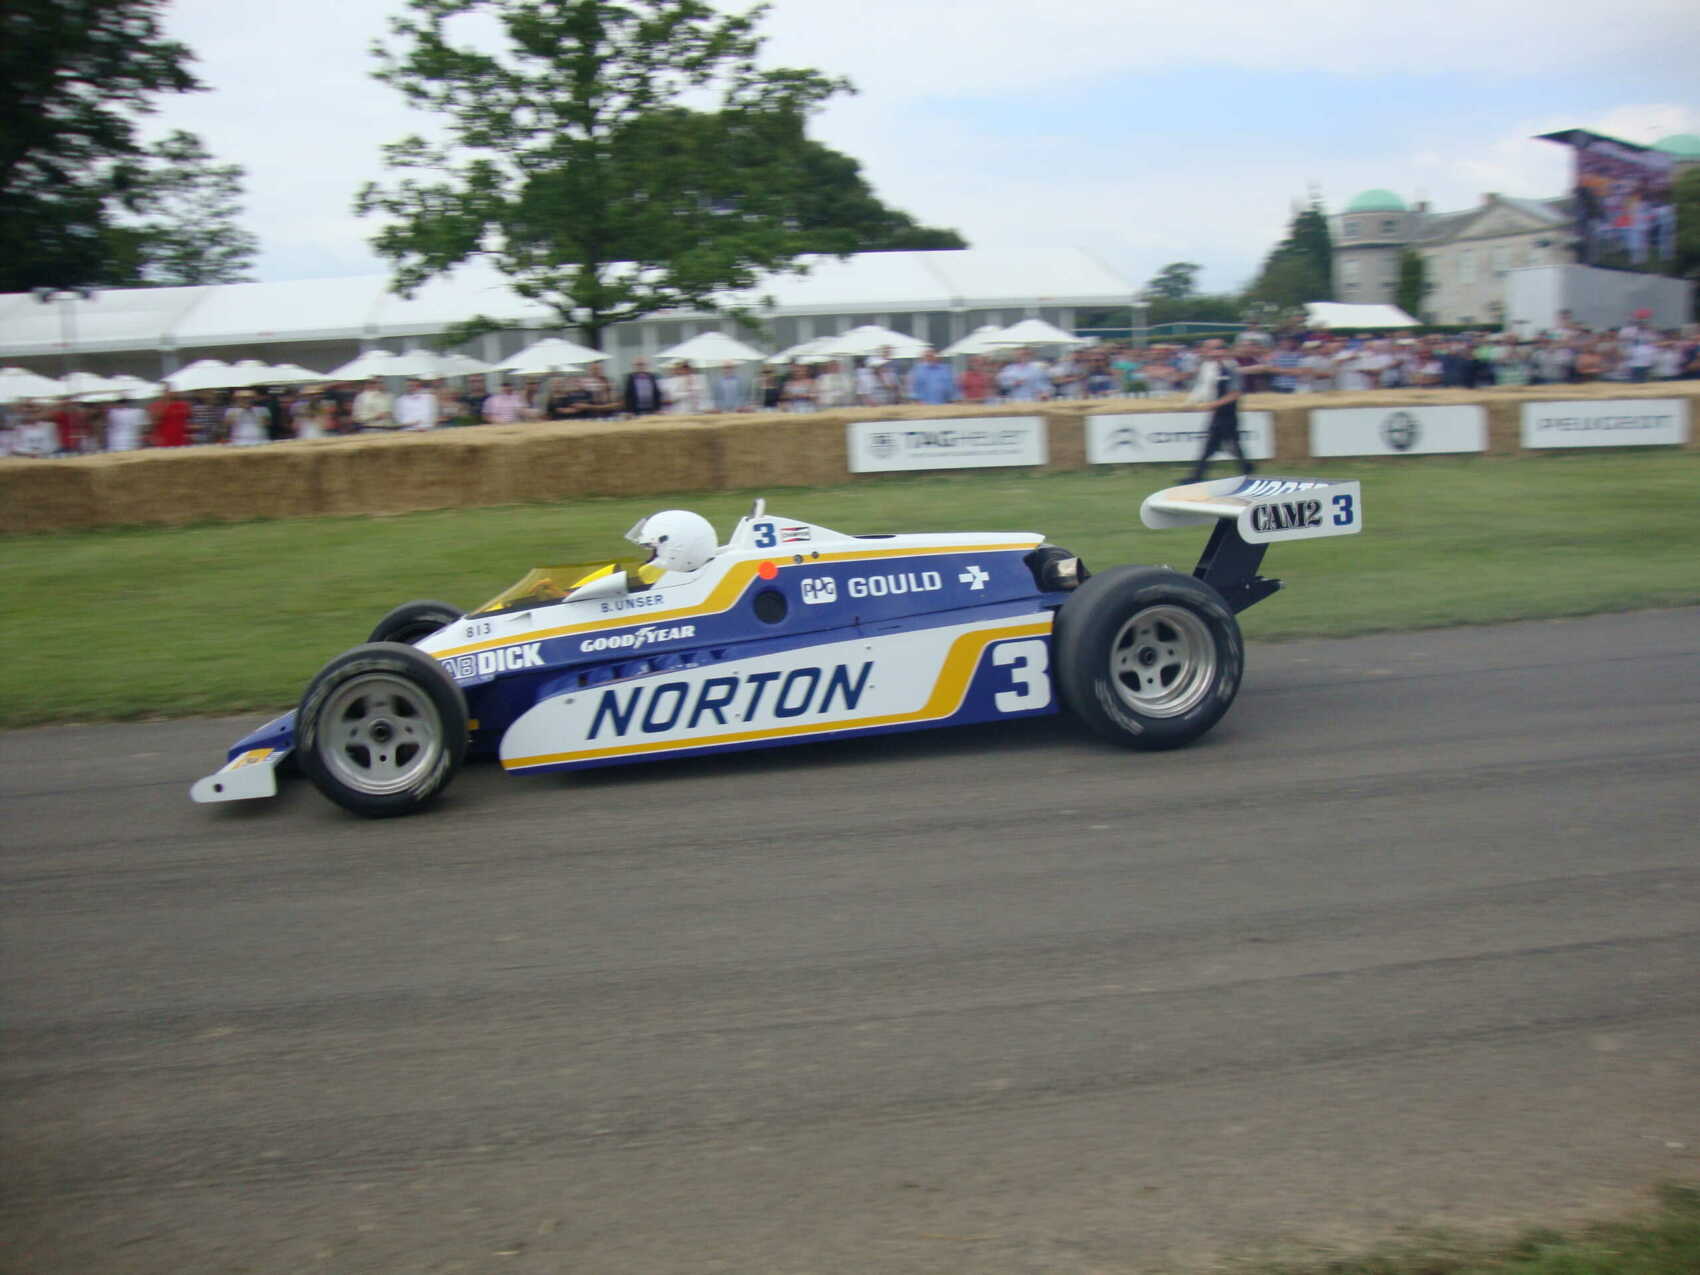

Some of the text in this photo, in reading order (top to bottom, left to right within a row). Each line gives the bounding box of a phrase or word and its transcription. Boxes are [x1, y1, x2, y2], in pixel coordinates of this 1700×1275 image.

[1252, 494, 1354, 533] CAM2 3
[753, 523, 777, 548] 3
[803, 570, 942, 600] PPG GOULD
[580, 624, 696, 653] GOODYEAR
[992, 639, 1051, 713] 3
[586, 661, 874, 740] NORTON
